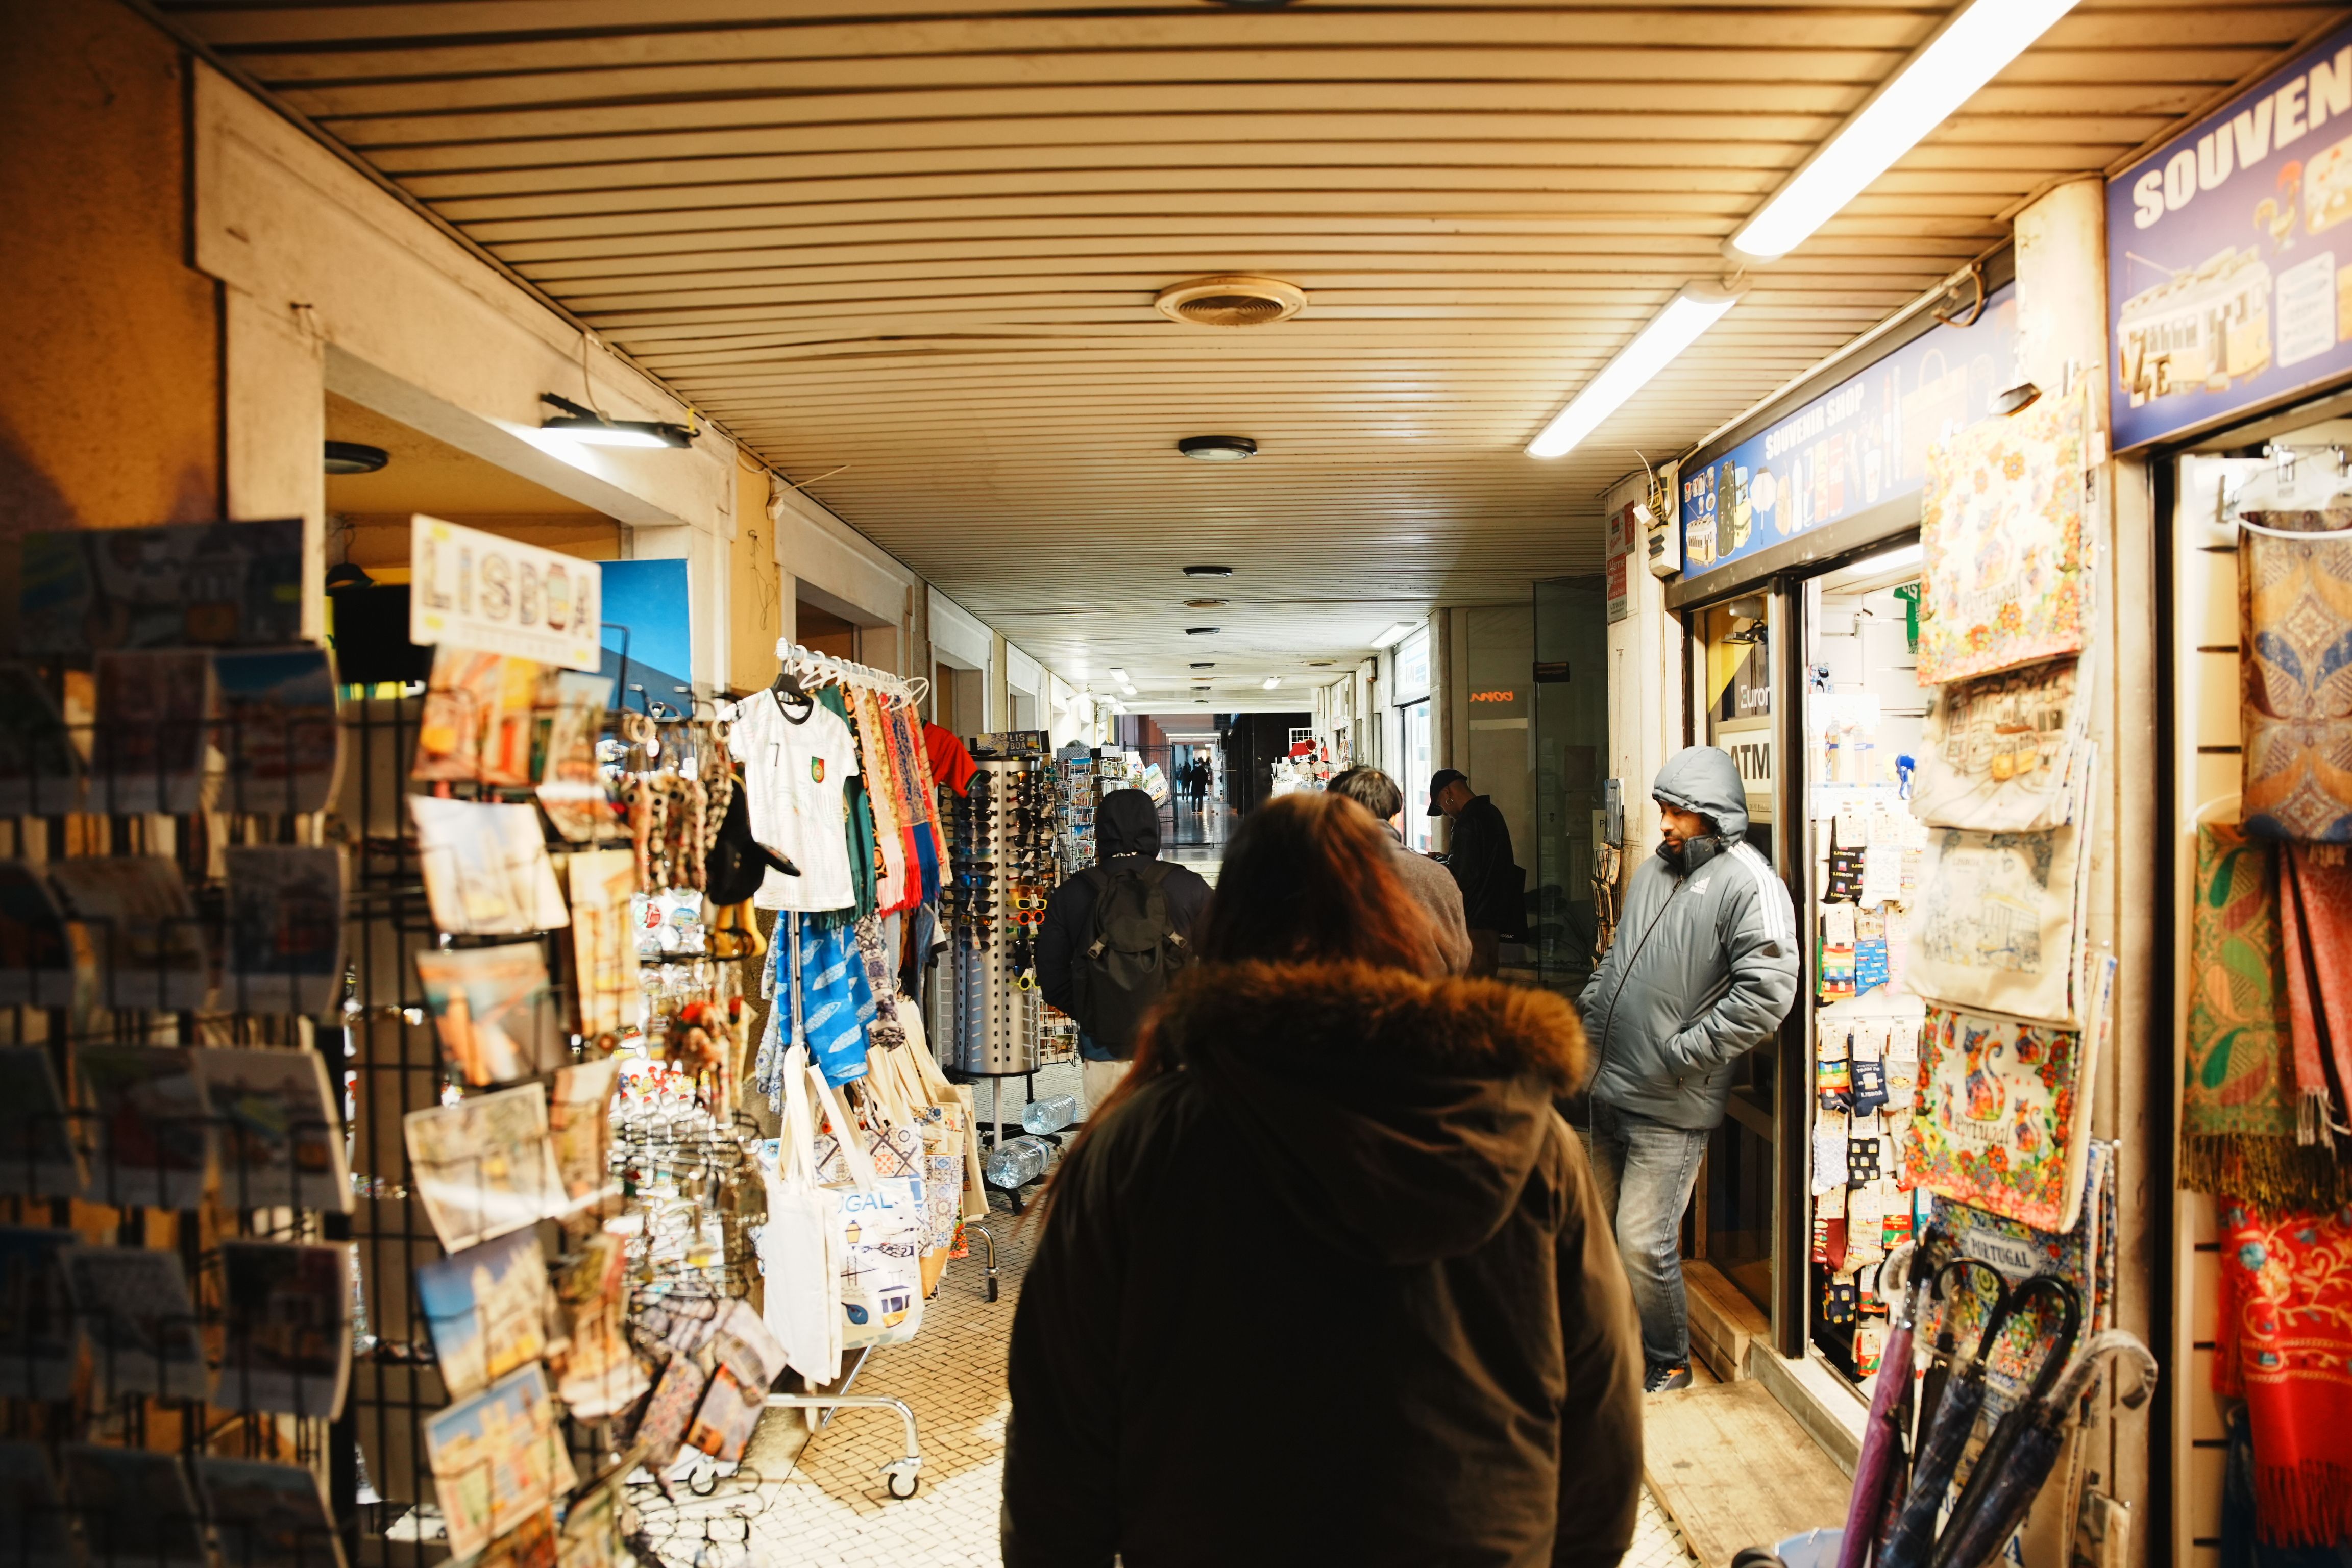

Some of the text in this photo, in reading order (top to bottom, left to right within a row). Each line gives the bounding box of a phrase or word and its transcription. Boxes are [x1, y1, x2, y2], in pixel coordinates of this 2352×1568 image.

[2133, 44, 2352, 229] SOUVEN
[1765, 382, 1865, 460] SOUVENIR SHOP
[1609, 558, 1626, 572] Alarme
[1010, 733, 1025, 742] LIS
[1010, 741, 1026, 750] BOA
[770, 742, 780, 767] 7
[1731, 743, 1770, 780] ATM
[1861, 1090, 1883, 1098] LISBOA
[1971, 1237, 2031, 1269] PORTUGAL
